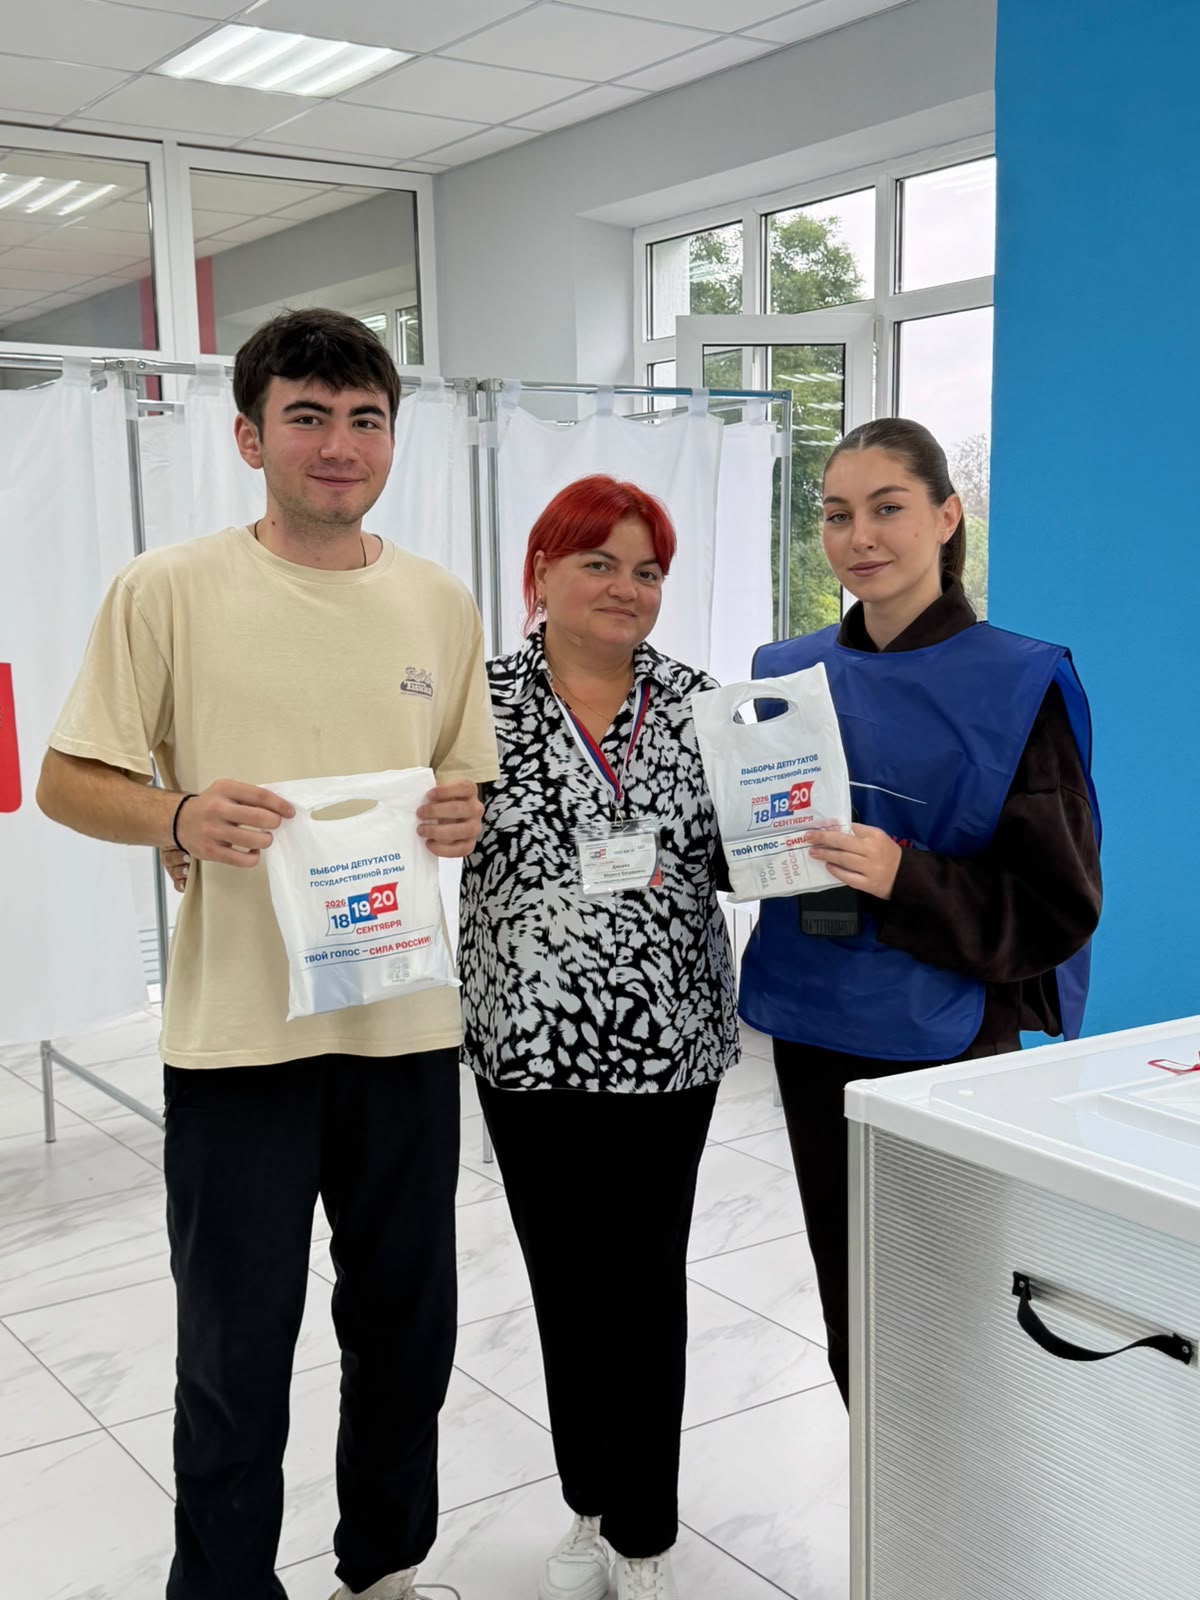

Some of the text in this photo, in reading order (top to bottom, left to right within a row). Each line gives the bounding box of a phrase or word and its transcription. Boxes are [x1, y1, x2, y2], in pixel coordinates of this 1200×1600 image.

[741, 754, 818, 775] ВЫБОРЫ ДЕПУТАТОВ
[740, 766, 821, 786] ГОСУДАРСТВЕННОЙ ДУМЫ
[751, 795, 769, 804] 2026
[754, 788, 809, 823] 18 19 20
[773, 815, 814, 828] СЕНТЯБРЯ
[731, 847, 753, 857] ТВОЙ
[753, 841, 779, 853] ГОЛОС
[310, 853, 401, 876] ВЫБОРЫ ДЕПУТАТОВ
[310, 865, 405, 888] ГОСУДАРСТВЕННОЙ ДУМЫ
[325, 899, 346, 908] 2026
[331, 890, 395, 929] 18 19 20
[356, 920, 402, 935] СЕНТЯБРЯ
[304, 953, 328, 963] ТВОЙ
[330, 949, 360, 959] ГОЛОС
[369, 944, 394, 955] СИЛА
